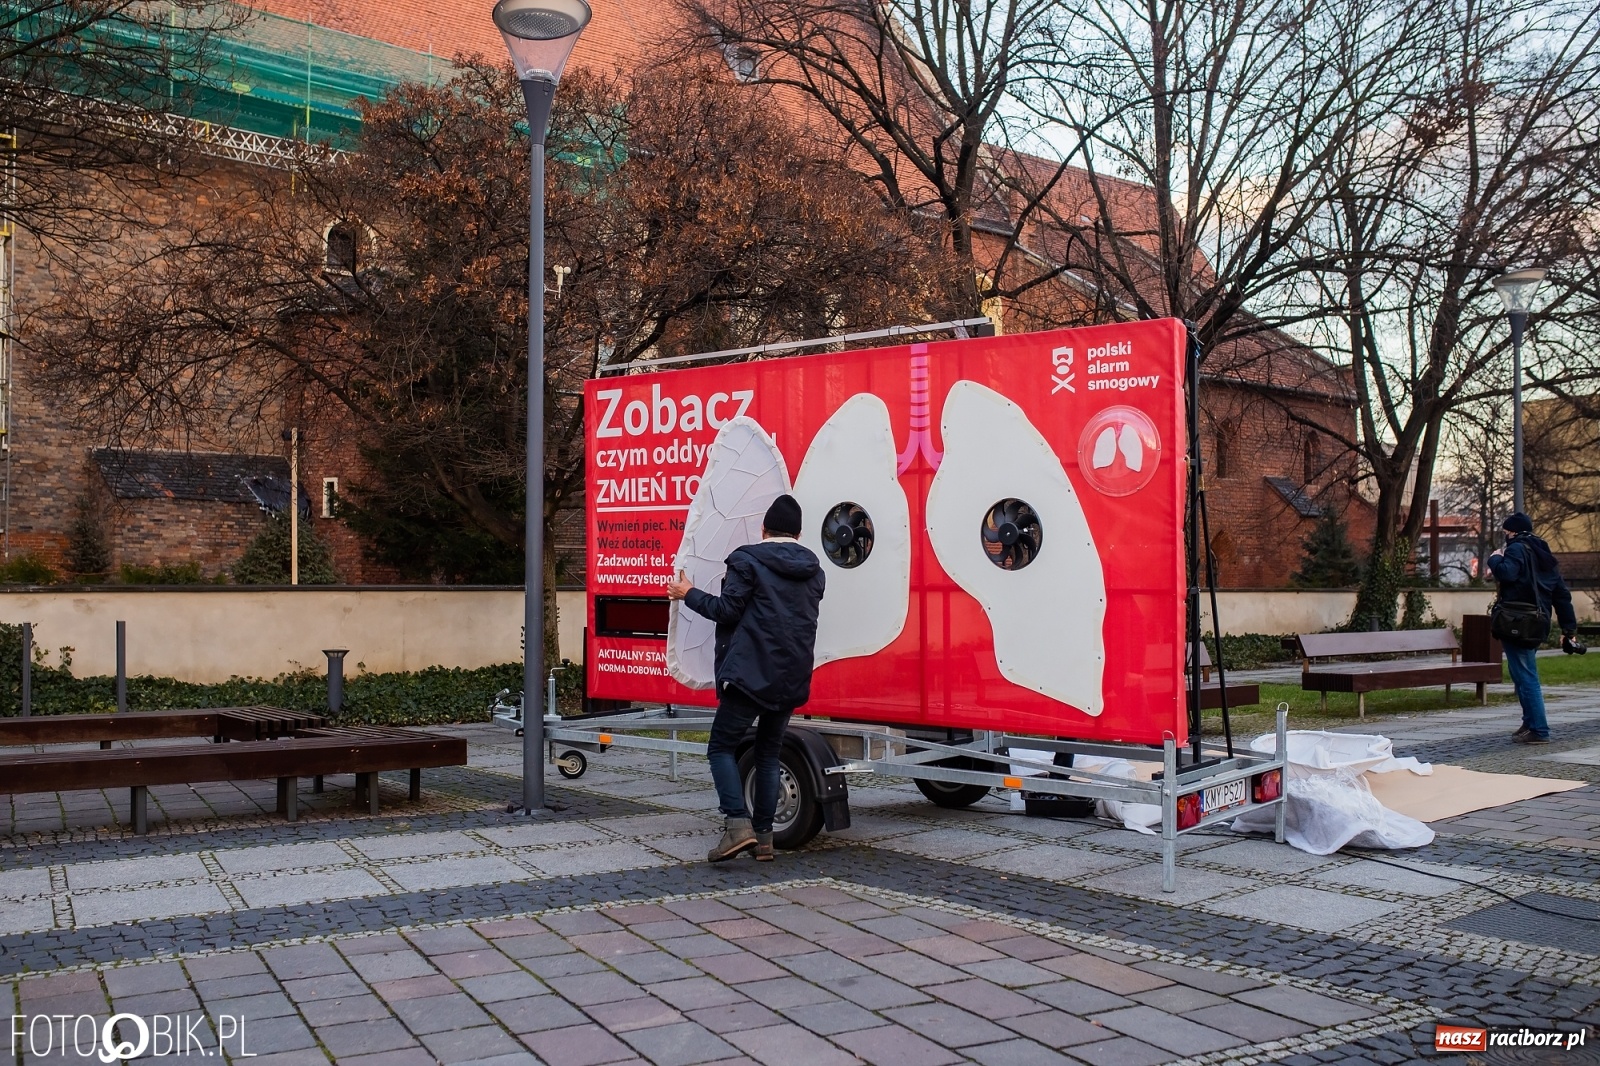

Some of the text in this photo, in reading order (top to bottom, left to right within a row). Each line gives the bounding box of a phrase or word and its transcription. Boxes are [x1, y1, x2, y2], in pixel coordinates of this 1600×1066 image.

[1087, 341, 1132, 361] polski
[1087, 360, 1130, 375] alarm
[1087, 375, 1160, 391] smogowy
[596, 383, 755, 439] Zobacz
[596, 445, 648, 471] czym
[596, 471, 667, 504] ZMIEŃ
[597, 519, 640, 534] Wymień
[642, 518, 667, 533] piec.
[597, 536, 664, 551] Weź dotację.
[596, 553, 648, 567] Zadzwoń!
[650, 553, 669, 567] tel.
[597, 572, 676, 587] www.czystepo
[598, 648, 645, 661] AKTUALNY
[598, 663, 673, 677] NORMA DOBOWA D
[1205, 787, 1222, 810] KMY
[1224, 781, 1243, 804] PS27
